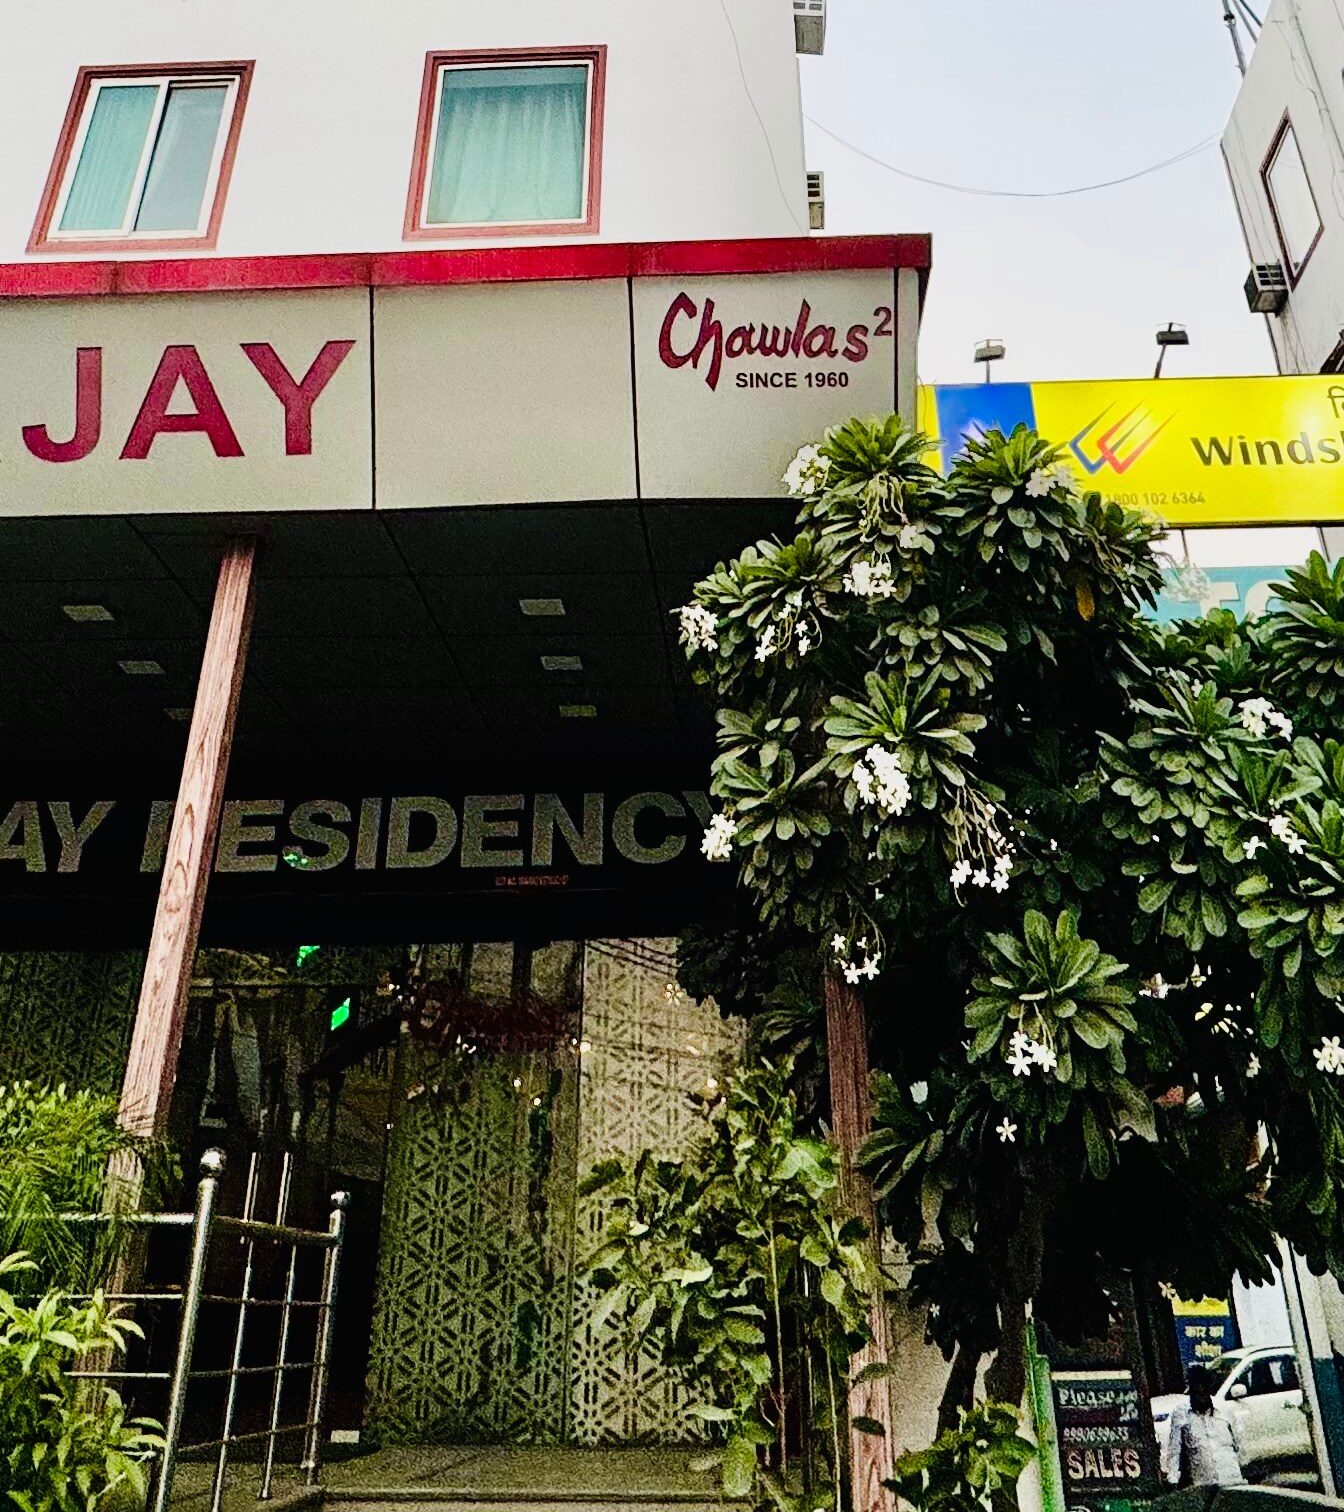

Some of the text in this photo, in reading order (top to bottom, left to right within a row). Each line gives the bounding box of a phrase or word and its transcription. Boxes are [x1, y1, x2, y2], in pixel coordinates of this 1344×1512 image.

[735, 372, 849, 388] SINCE 1960
[1143, 491, 1169, 506] 102
[1171, 491, 1206, 505] 6364
[140, 791, 732, 873] ESIDENC
[1057, 1388, 1116, 1407] Please
[1067, 1447, 1141, 1480] SALES
